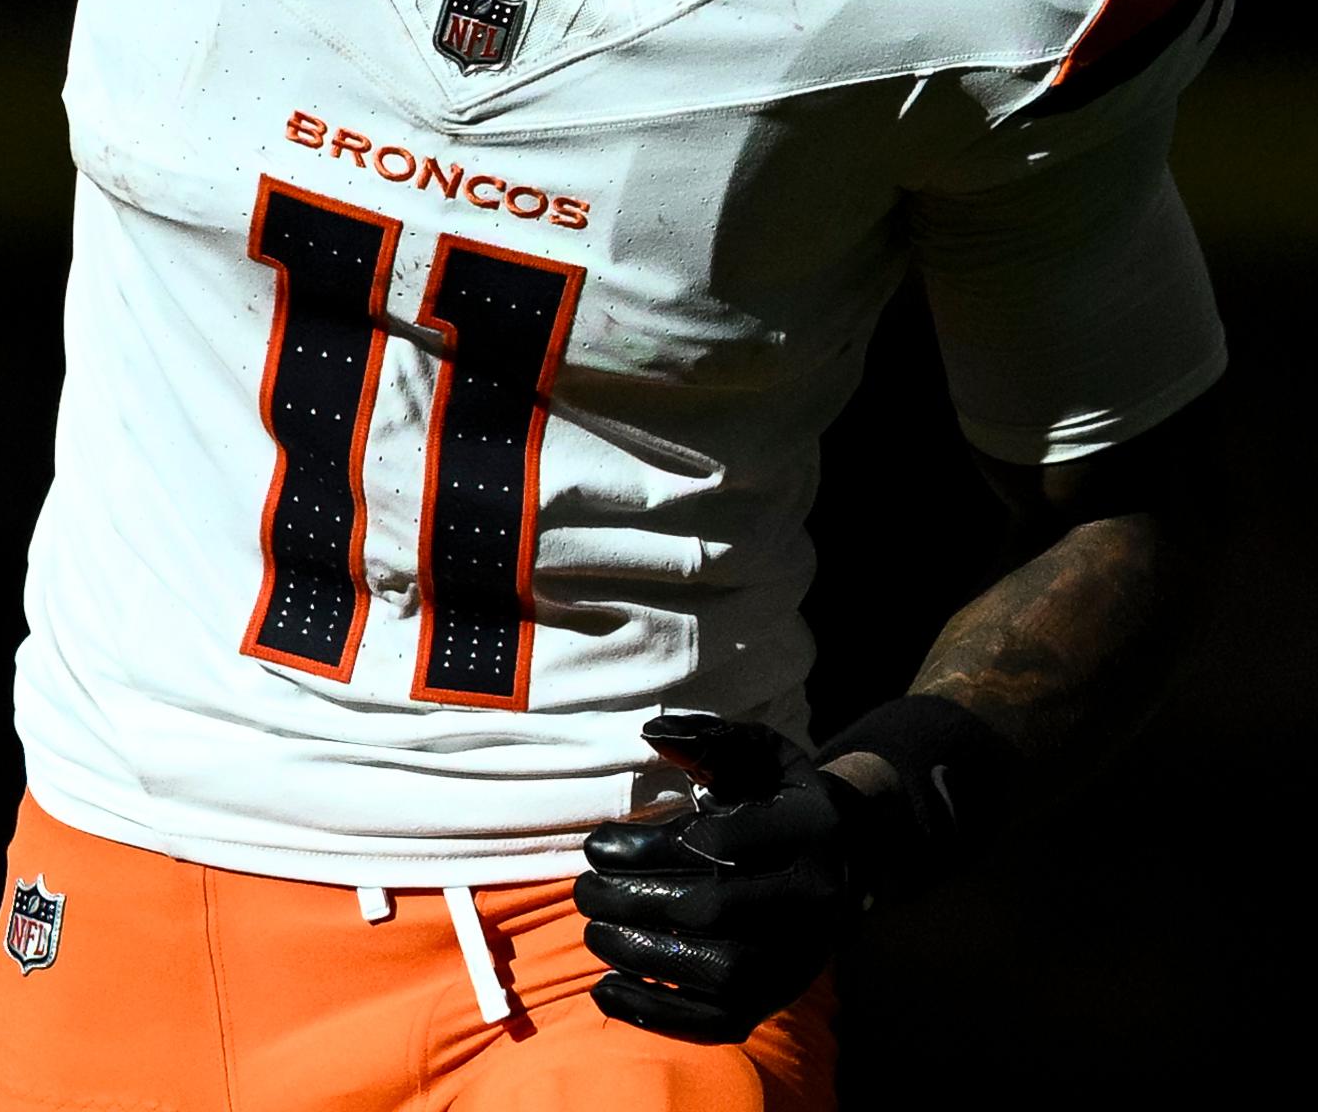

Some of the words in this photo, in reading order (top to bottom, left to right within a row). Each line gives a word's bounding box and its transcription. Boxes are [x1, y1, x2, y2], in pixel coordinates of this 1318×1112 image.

[442, 15, 500, 58] NFL
[286, 110, 590, 229] BRONCOS
[239, 173, 587, 711] 11
[9, 914, 45, 957] NFL
